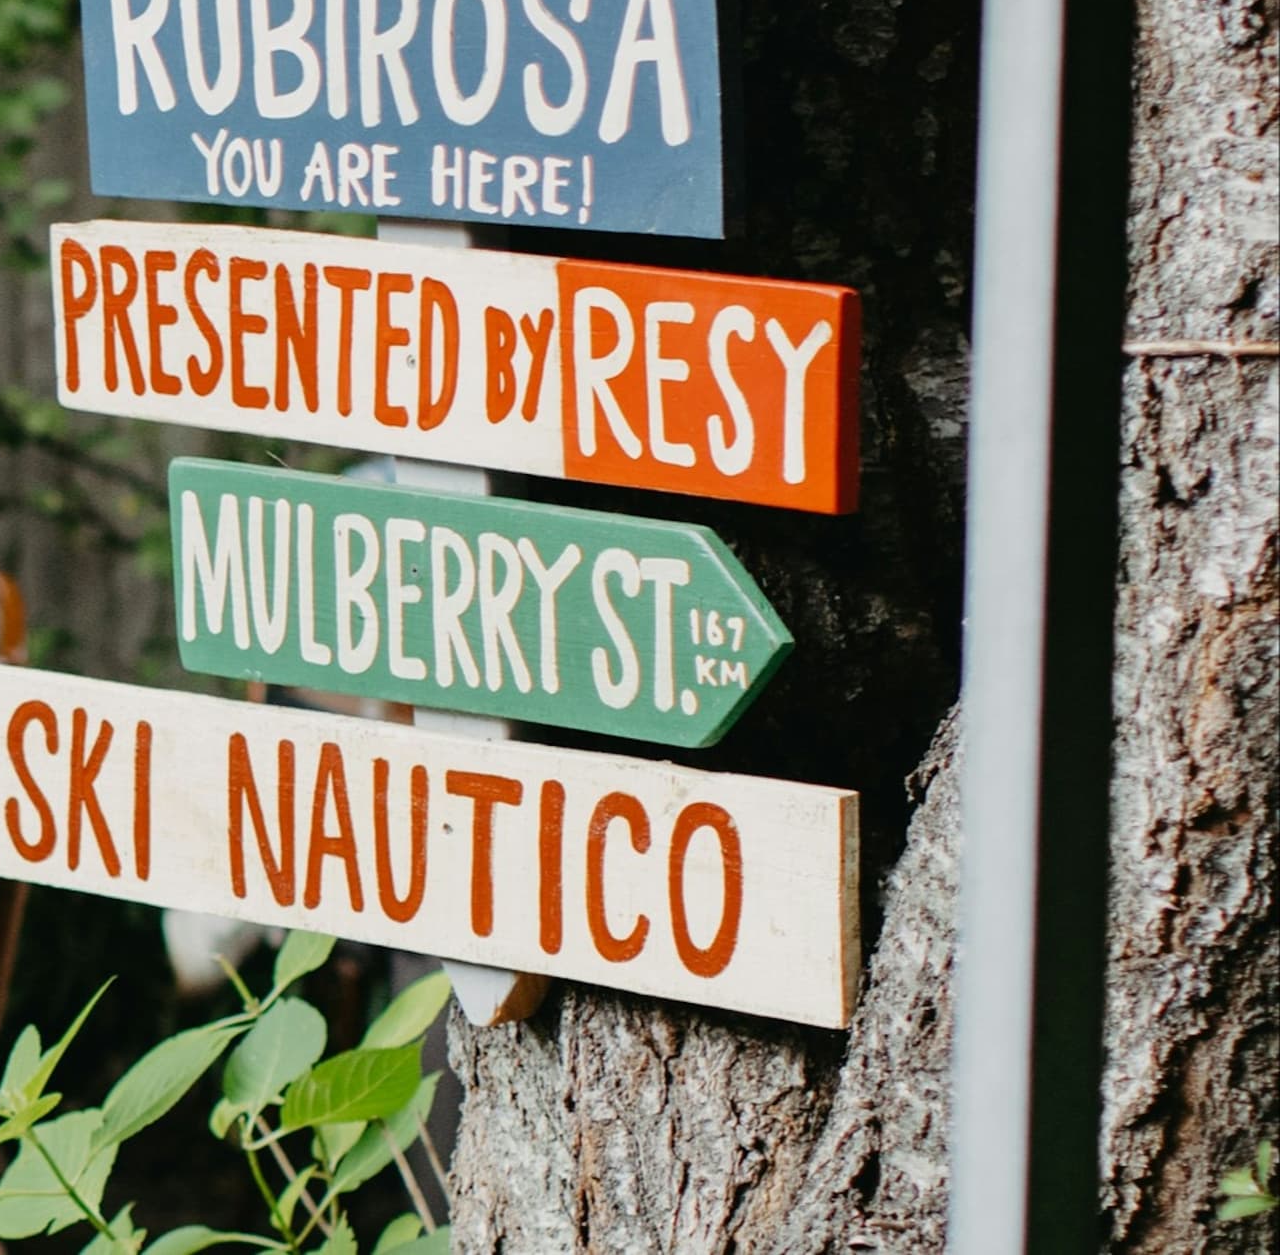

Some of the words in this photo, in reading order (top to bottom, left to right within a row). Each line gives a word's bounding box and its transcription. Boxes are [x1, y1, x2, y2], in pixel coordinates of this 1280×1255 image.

[191, 128, 283, 199] YOU
[302, 141, 401, 209] ARE
[430, 143, 595, 225] HERE!
[59, 238, 460, 432] PRESENTED
[483, 305, 555, 425] BY
[573, 286, 832, 485] RESY
[180, 489, 584, 695] MULBERRY
[590, 546, 699, 716] ST.
[688, 607, 745, 653] 167
[694, 654, 749, 691] KM
[4, 699, 153, 882] SKI
[227, 732, 743, 979] NAUTICO
